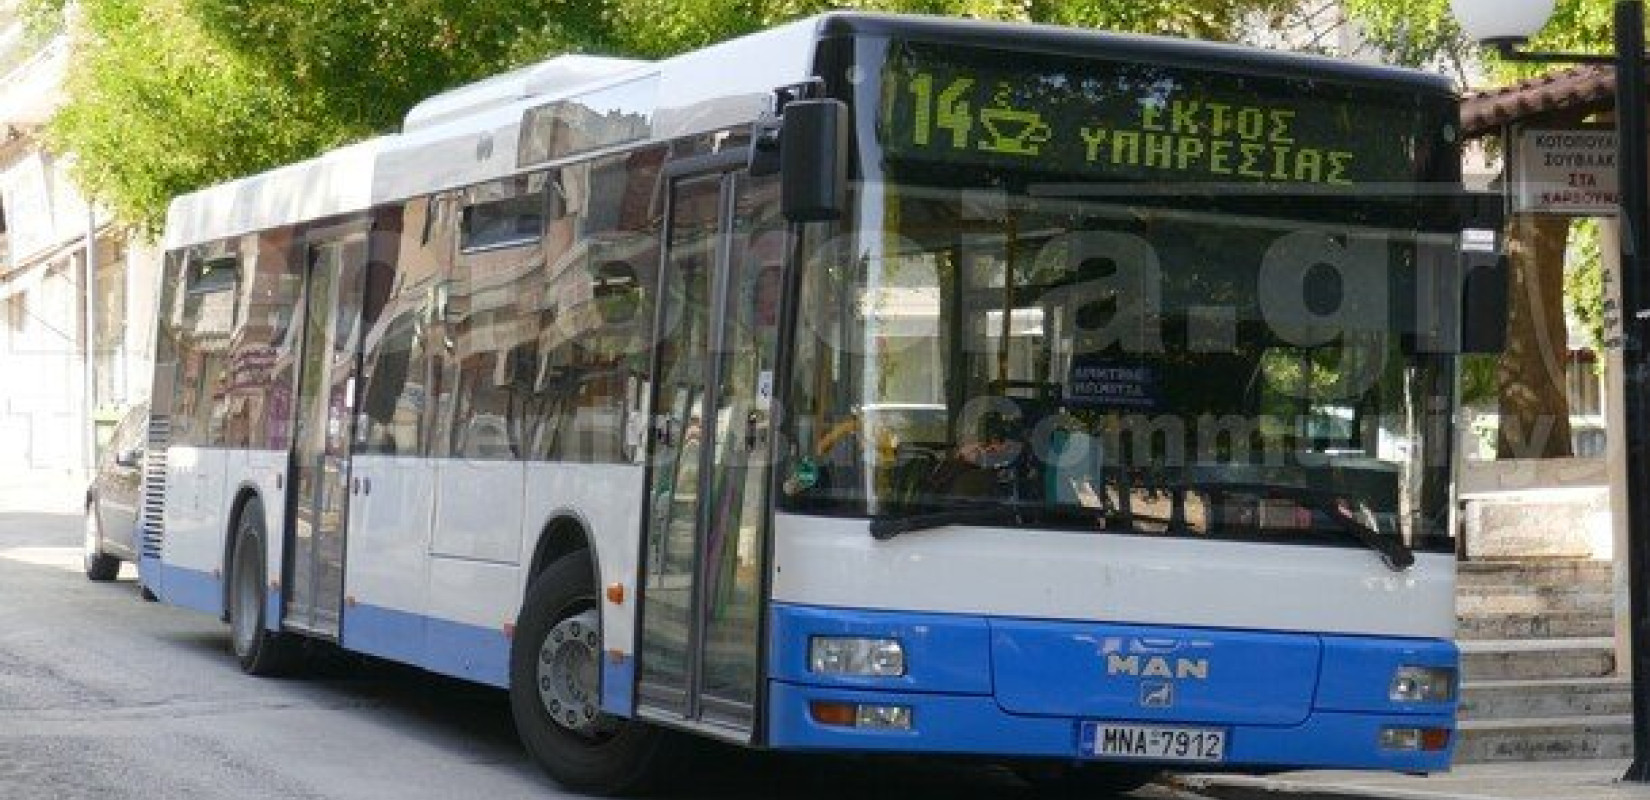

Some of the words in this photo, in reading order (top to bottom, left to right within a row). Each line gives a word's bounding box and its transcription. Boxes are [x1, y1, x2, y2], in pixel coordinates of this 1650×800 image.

[910, 73, 976, 148] 14
[1142, 99, 1296, 144] ΕΚΤΟΣ
[1536, 135, 1619, 149] ΚΟΤΟΠΟΥΛ
[1080, 127, 1353, 185] ΥΠΗΡΕΣΙΑΣ
[1544, 154, 1617, 168] ΣΟΥΒΛΑΚ
[1568, 173, 1597, 187] ΣΤΑ
[1107, 655, 1209, 679] MAN
